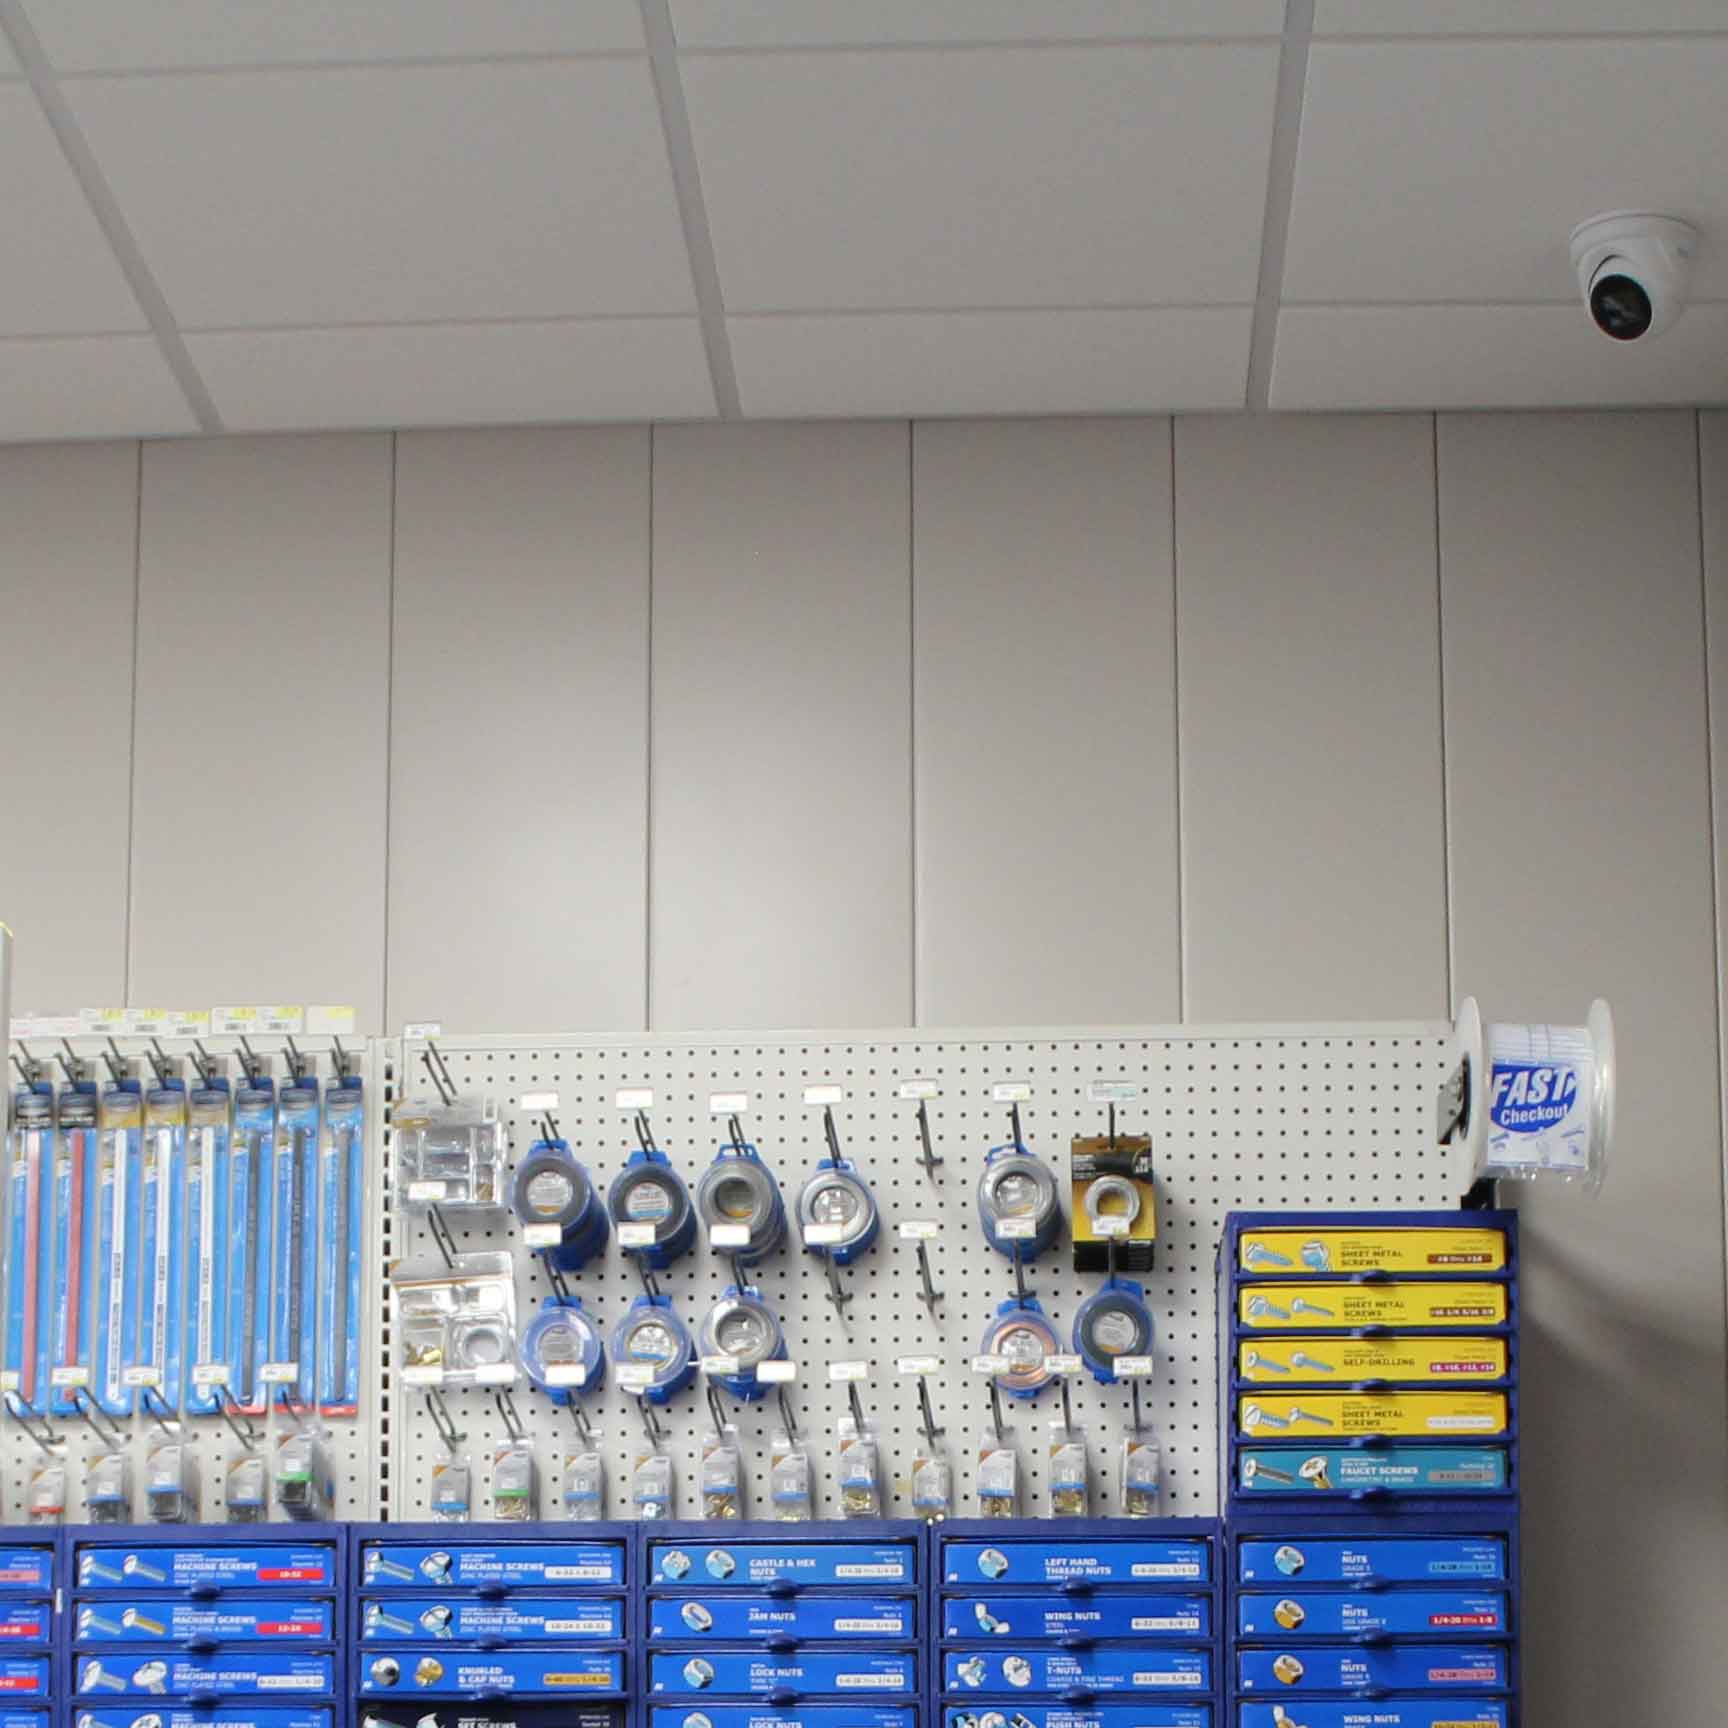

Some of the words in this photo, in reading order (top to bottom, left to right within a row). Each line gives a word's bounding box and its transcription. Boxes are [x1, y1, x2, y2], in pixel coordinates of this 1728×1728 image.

[1491, 1065, 1571, 1108] FAST
[1500, 1103, 1569, 1125] Checkout
[1343, 1358, 1415, 1366] SELF-DRILLING
